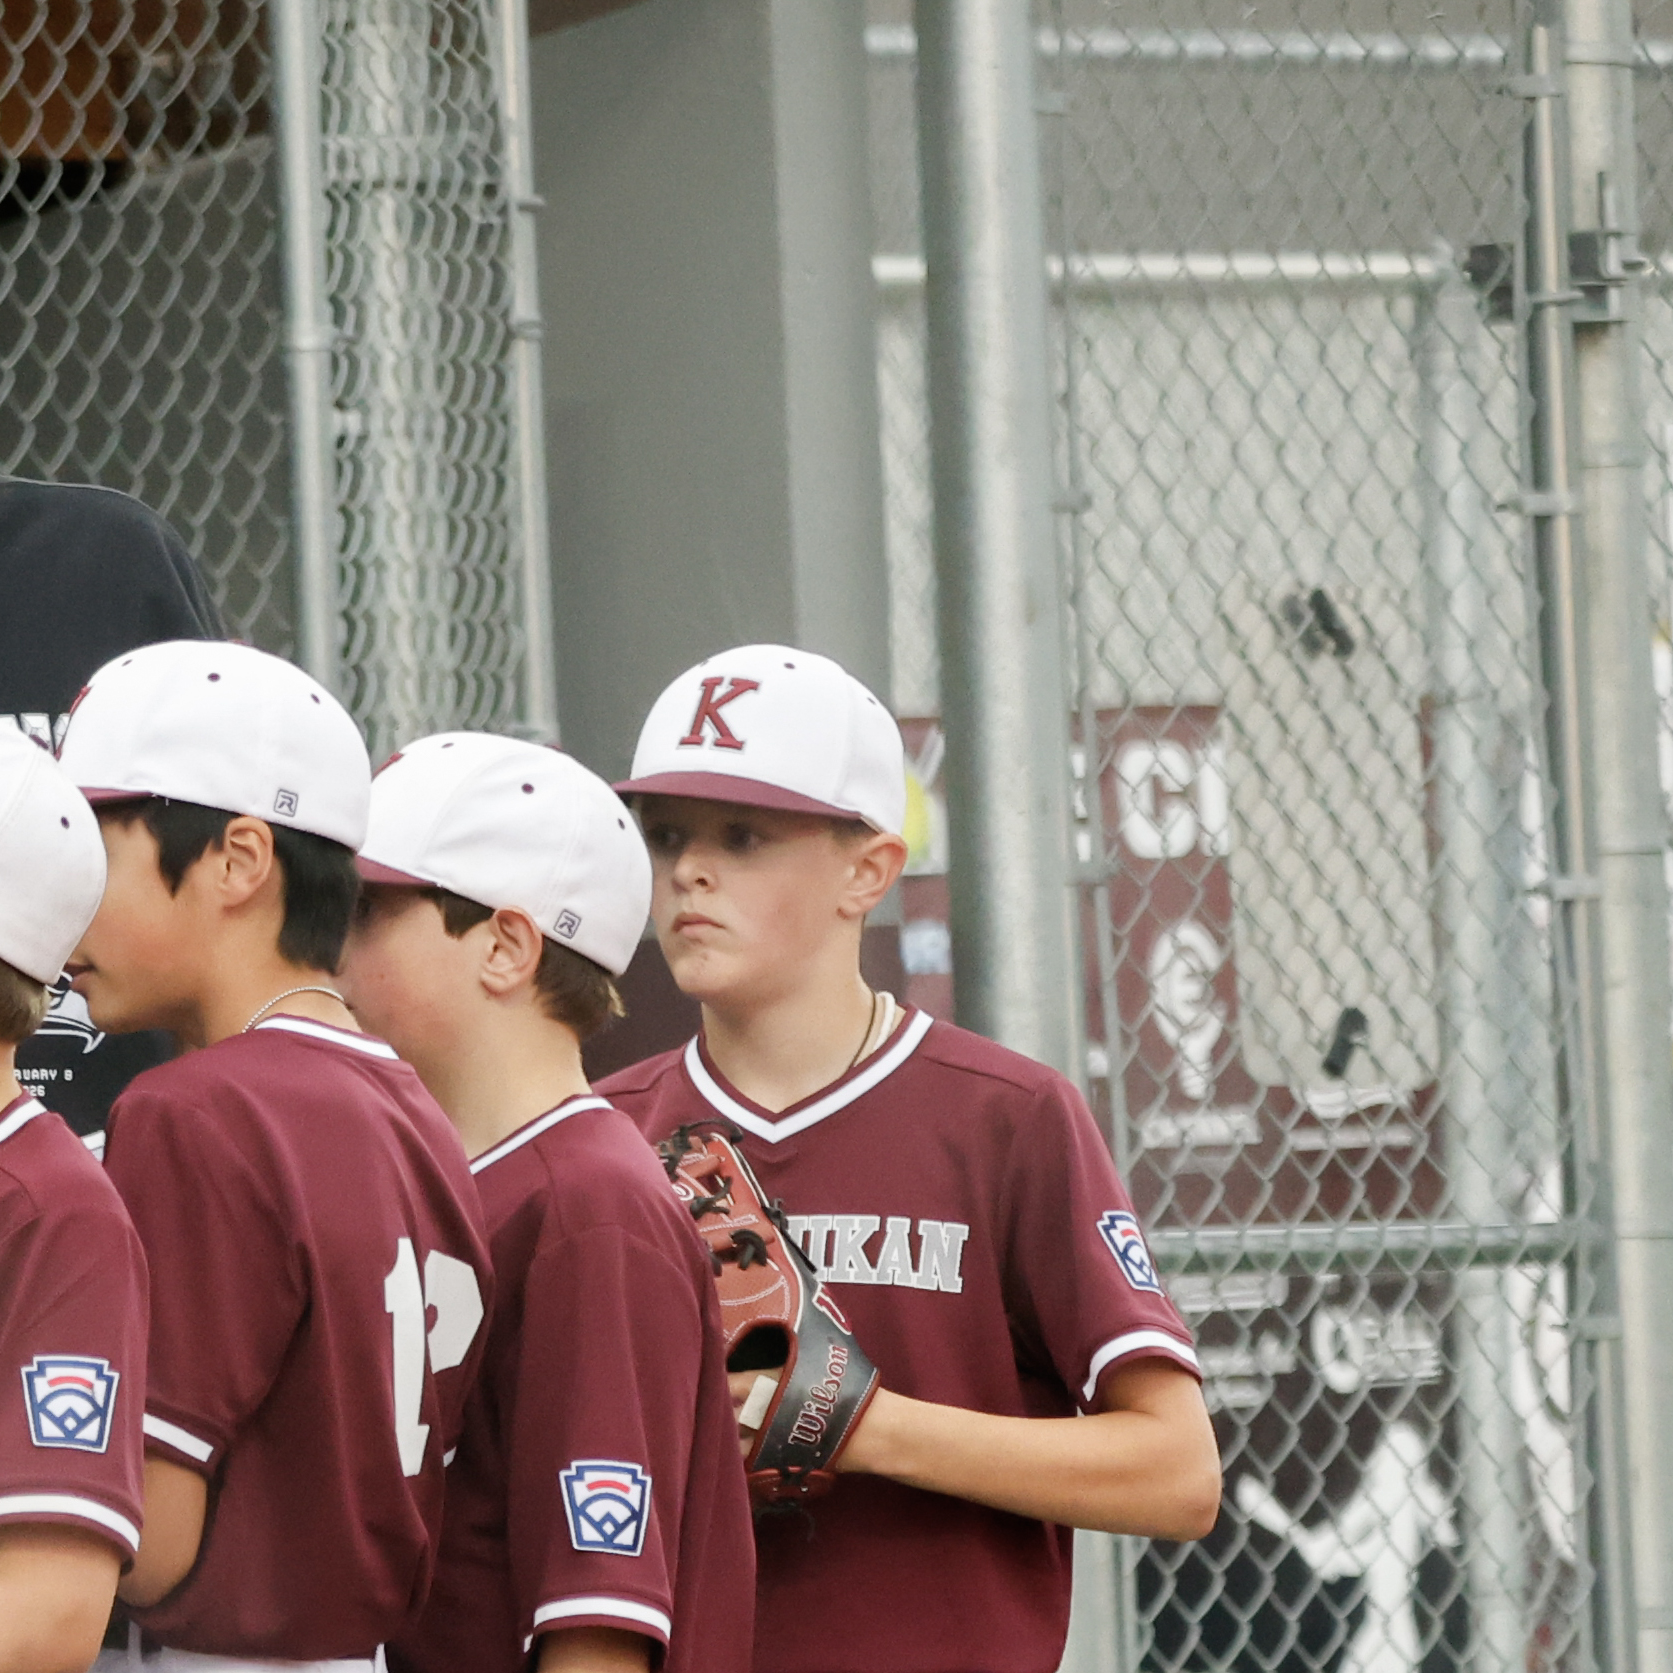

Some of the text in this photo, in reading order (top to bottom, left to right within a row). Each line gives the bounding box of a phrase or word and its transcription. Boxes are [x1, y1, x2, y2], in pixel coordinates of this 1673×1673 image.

[679, 675, 760, 750] K
[13, 1068, 58, 1081] RUARY
[788, 1344, 848, 1446] Wilson
